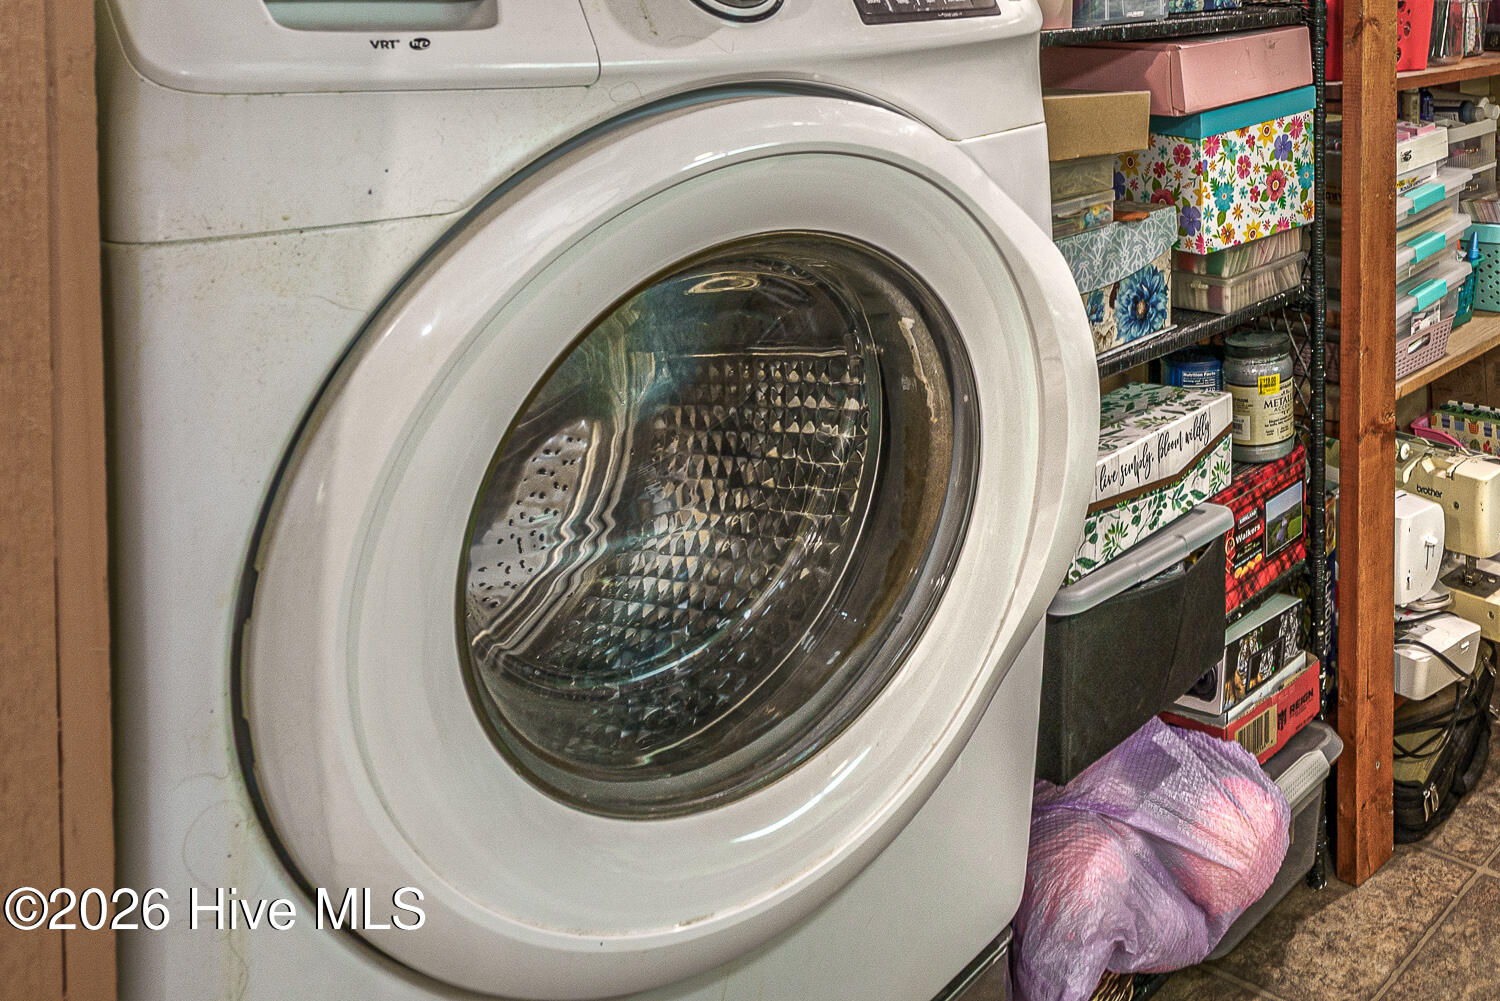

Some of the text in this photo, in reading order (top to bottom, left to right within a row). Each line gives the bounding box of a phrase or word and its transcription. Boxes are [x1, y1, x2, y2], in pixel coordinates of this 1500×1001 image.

[1100, 464, 1118, 492] live
[1158, 431, 1182, 463] bloom
[1185, 412, 1210, 446] wildly
[1416, 483, 1443, 498] brother
[1235, 524, 1261, 544] Walkers
[1289, 688, 1313, 715] REIGN
